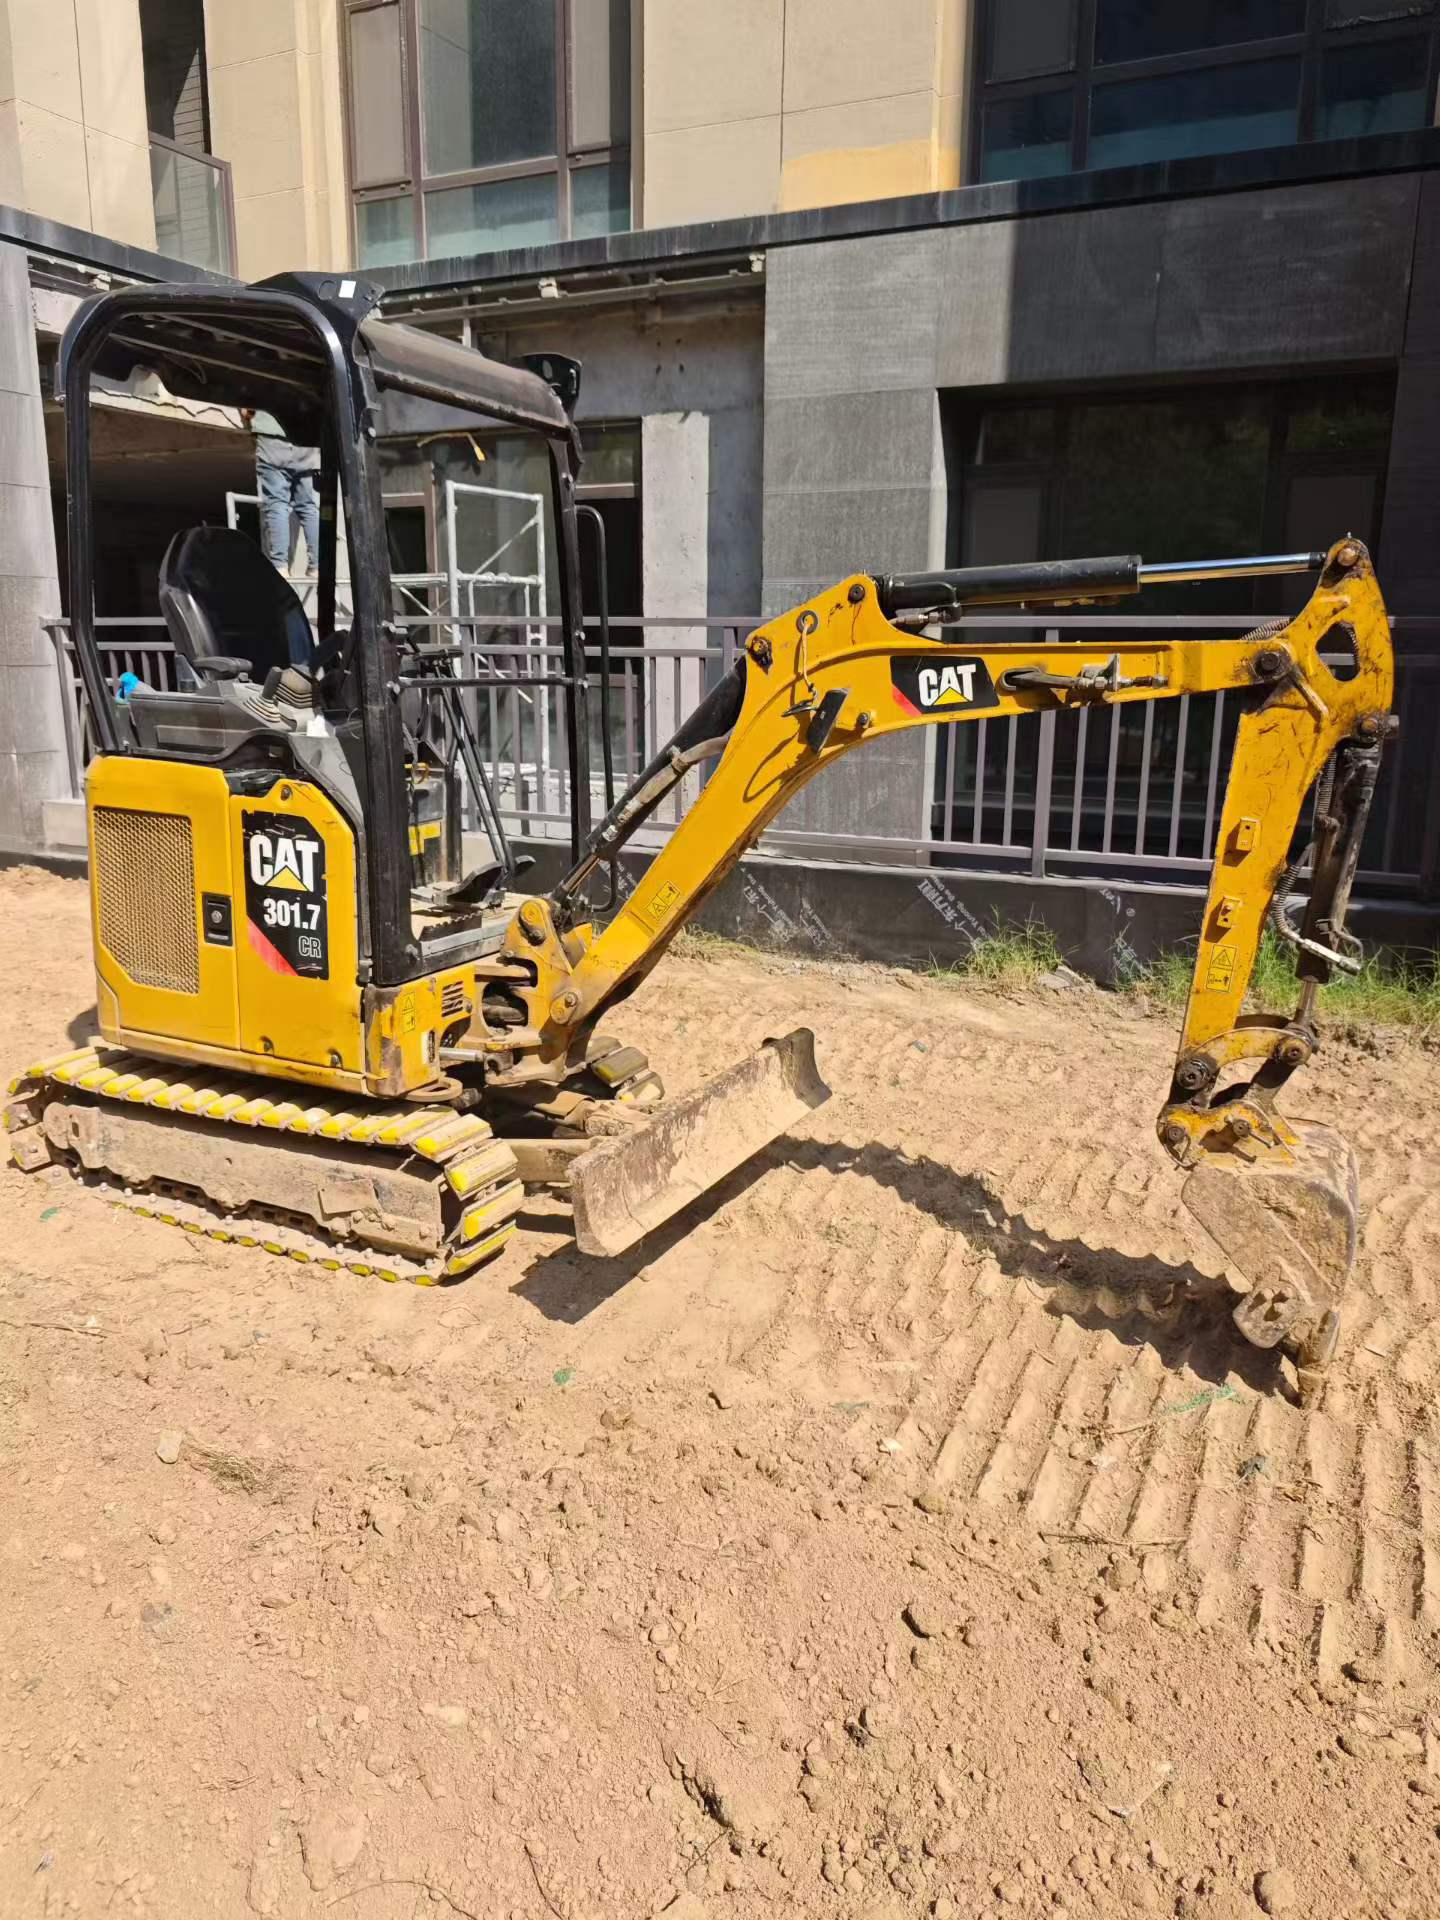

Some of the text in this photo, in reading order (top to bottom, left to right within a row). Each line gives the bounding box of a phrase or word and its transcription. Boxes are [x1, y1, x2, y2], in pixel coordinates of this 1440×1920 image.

[918, 663, 977, 707] CAT
[250, 834, 319, 892] CAT
[263, 898, 321, 930] 301.7
[298, 936, 321, 958] CR
